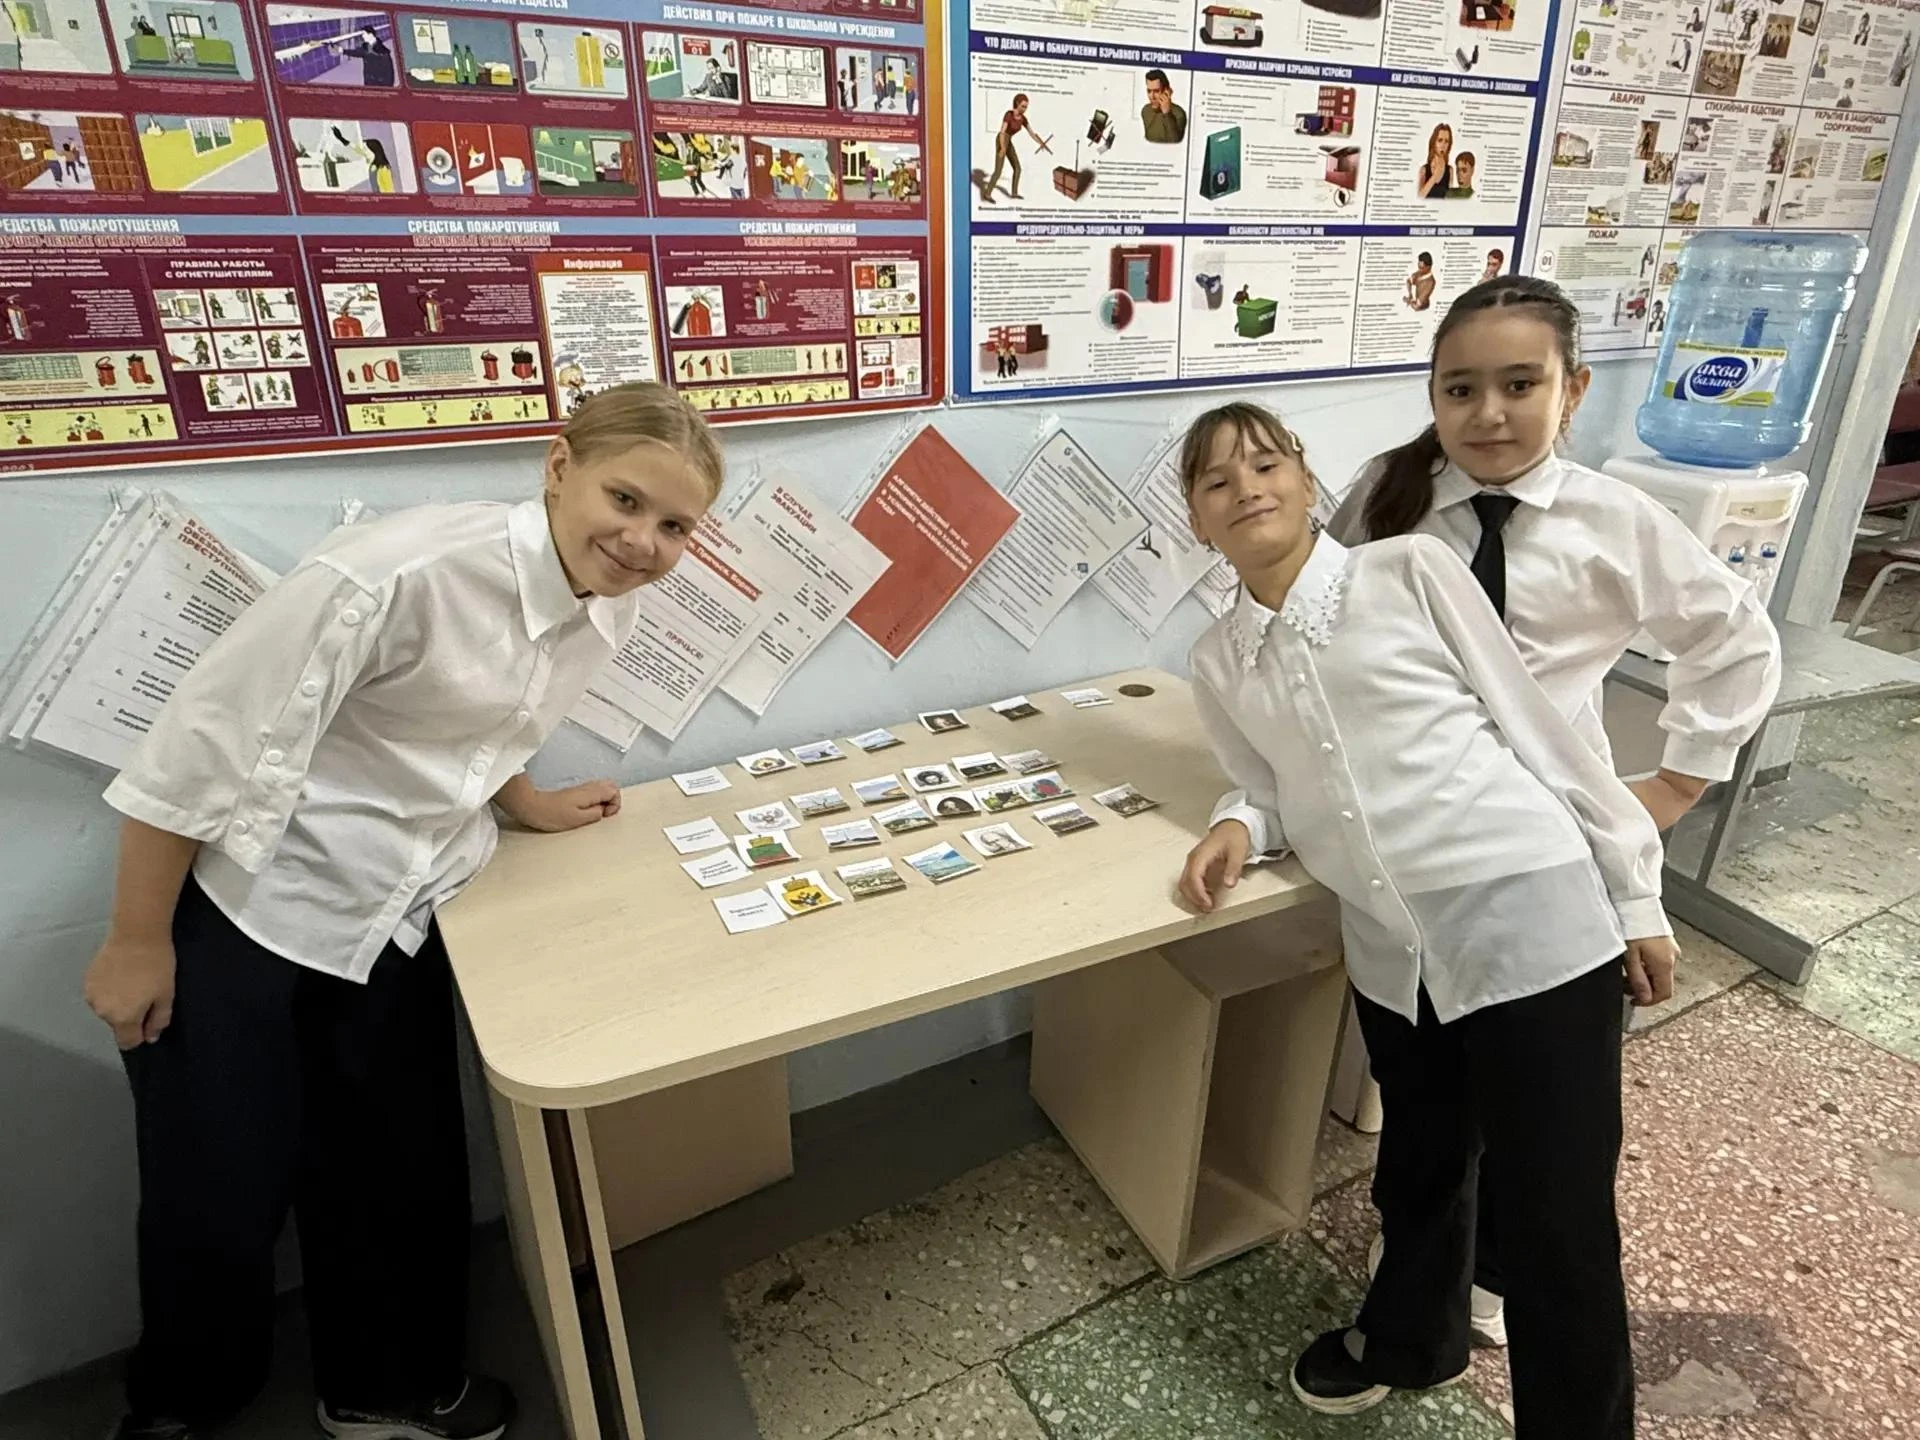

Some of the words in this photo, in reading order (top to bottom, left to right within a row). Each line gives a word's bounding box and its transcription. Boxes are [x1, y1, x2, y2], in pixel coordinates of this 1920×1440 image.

[663, 5, 712, 22] ДЕЙСТВИЯ
[715, 11, 736, 24] ПРИ
[737, 14, 775, 28] ПОЖАРЕ
[777, 17, 785, 29] В
[786, 17, 838, 33] ШКОЛЬНОМ
[839, 22, 896, 39] УЧРЕЖДЕНИИ
[984, 36, 999, 48] ЧТО
[1000, 38, 1028, 51] ДЕЛАТЬ
[1029, 41, 1045, 52] ПРИ
[1046, 43, 1098, 57] ОБНАРУЖЕНИИ
[1099, 46, 1140, 60] ВЗРЫВНОГО
[1141, 50, 1182, 64] УСТРОЙСТВА
[1225, 58, 1258, 71] ПРИЗНАКИ
[1321, 67, 1353, 78] УСТРОЙСТВ
[1609, 92, 1646, 105] АВАРИЯ
[1704, 101, 1749, 115] СТИХИЙНЫЕ
[60, 218, 180, 233] ПОЖАРОТУШЕНИЯ
[408, 220, 464, 233] СРЕДСТВА
[466, 221, 561, 233] ПОЖАРОТУШЕНИЯ
[739, 222, 783, 234] СРЕДСТВА
[785, 223, 857, 234] ПОЖАРОТУШЕНИЯ
[1124, 225, 1145, 235] МЕРЫ
[1588, 230, 1619, 239] ПОЖАР
[170, 261, 221, 269] ПРАВИЛА
[222, 260, 266, 268] РАБОТЫ
[563, 259, 623, 270] Информация
[165, 271, 173, 279] С
[175, 270, 273, 279] ОГНЕТУШИТЕЛЯМИ
[1697, 363, 1742, 379] аква
[1692, 374, 1738, 389] баланс
[776, 486, 783, 495] В
[783, 492, 813, 520] СЛУЧАЕ
[771, 493, 817, 534] ЭВАКУАЦИИ
[665, 630, 704, 660] ПРЯЧЬСЯ!
